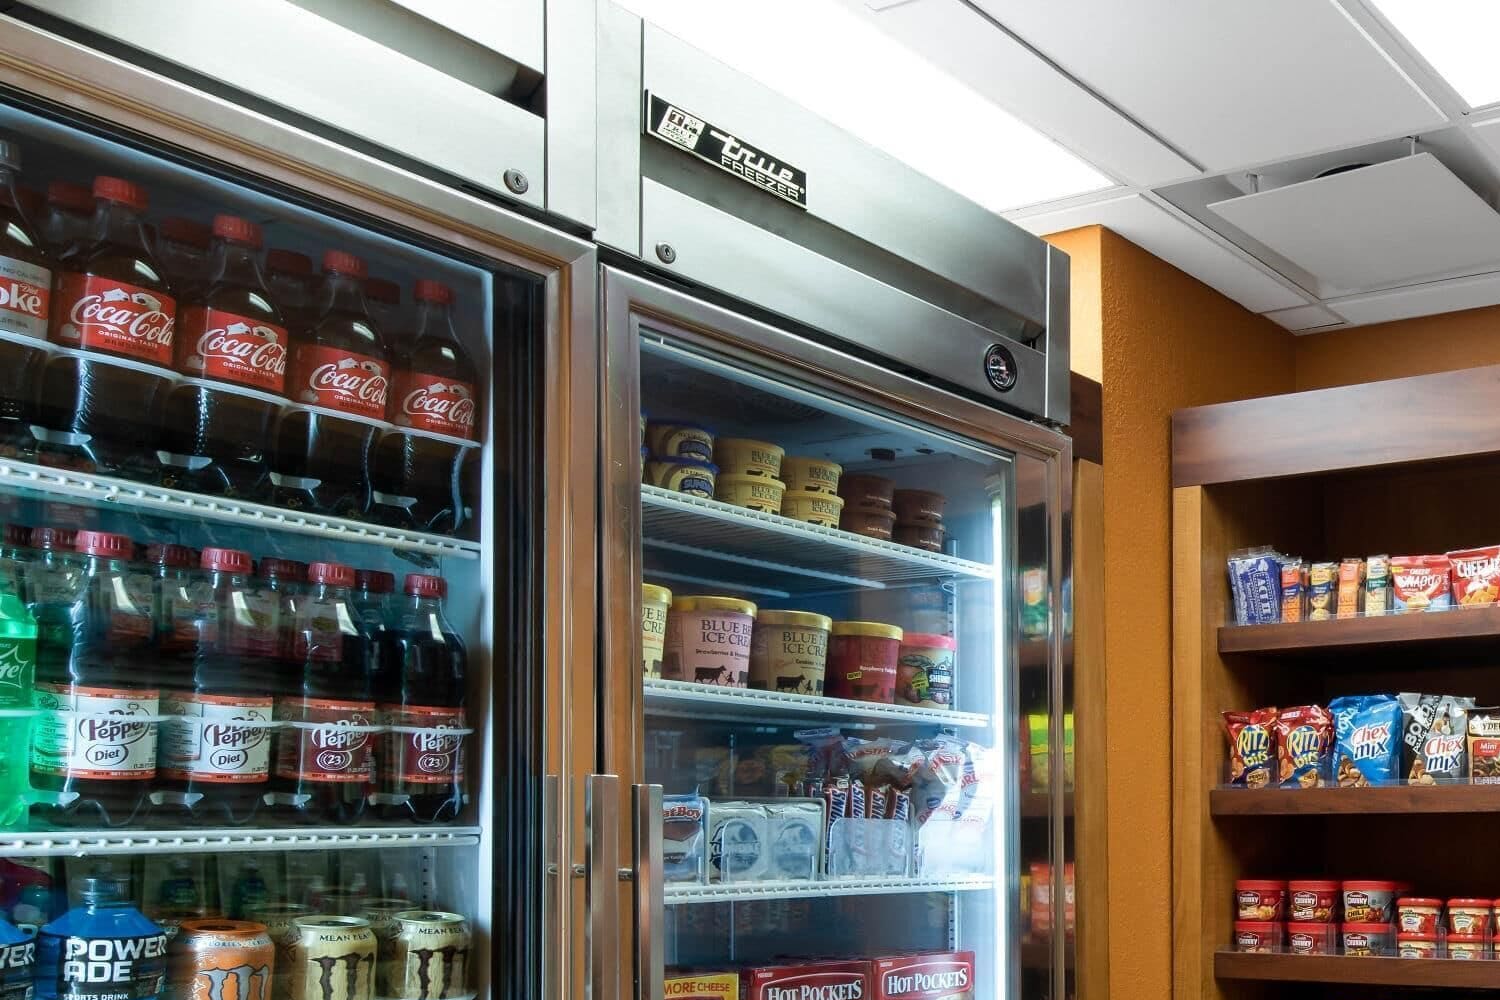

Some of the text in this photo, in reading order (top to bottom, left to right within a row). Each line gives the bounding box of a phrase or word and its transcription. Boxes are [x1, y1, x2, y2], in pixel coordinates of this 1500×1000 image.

[711, 130, 801, 190] true
[721, 155, 799, 200] FREEZER
[71, 295, 176, 346] Coca-Cola
[98, 330, 158, 349] ORIGINAL TASTE
[197, 328, 286, 375] Coca-Cola
[223, 361, 253, 372] ORIGINAL
[701, 619, 740, 632] BLUE
[701, 631, 727, 644] ICE
[782, 631, 817, 645] BLUE
[782, 643, 805, 655] ICE
[1239, 729, 1267, 754] RITZ
[1290, 730, 1320, 754] RITZ
[1351, 722, 1389, 747] Chex
[94, 749, 120, 762] Diet
[1424, 735, 1464, 757] Chex
[218, 753, 241, 766] Diet
[319, 934, 350, 942] MEAN
[418, 927, 447, 935] MEAN
[65, 935, 168, 961] POWER
[63, 961, 132, 983] ADE
[887, 968, 968, 995] HOT POCKETS
[64, 993, 129, 1000] SPORTS DRINK
[697, 982, 731, 992] CHEESE
